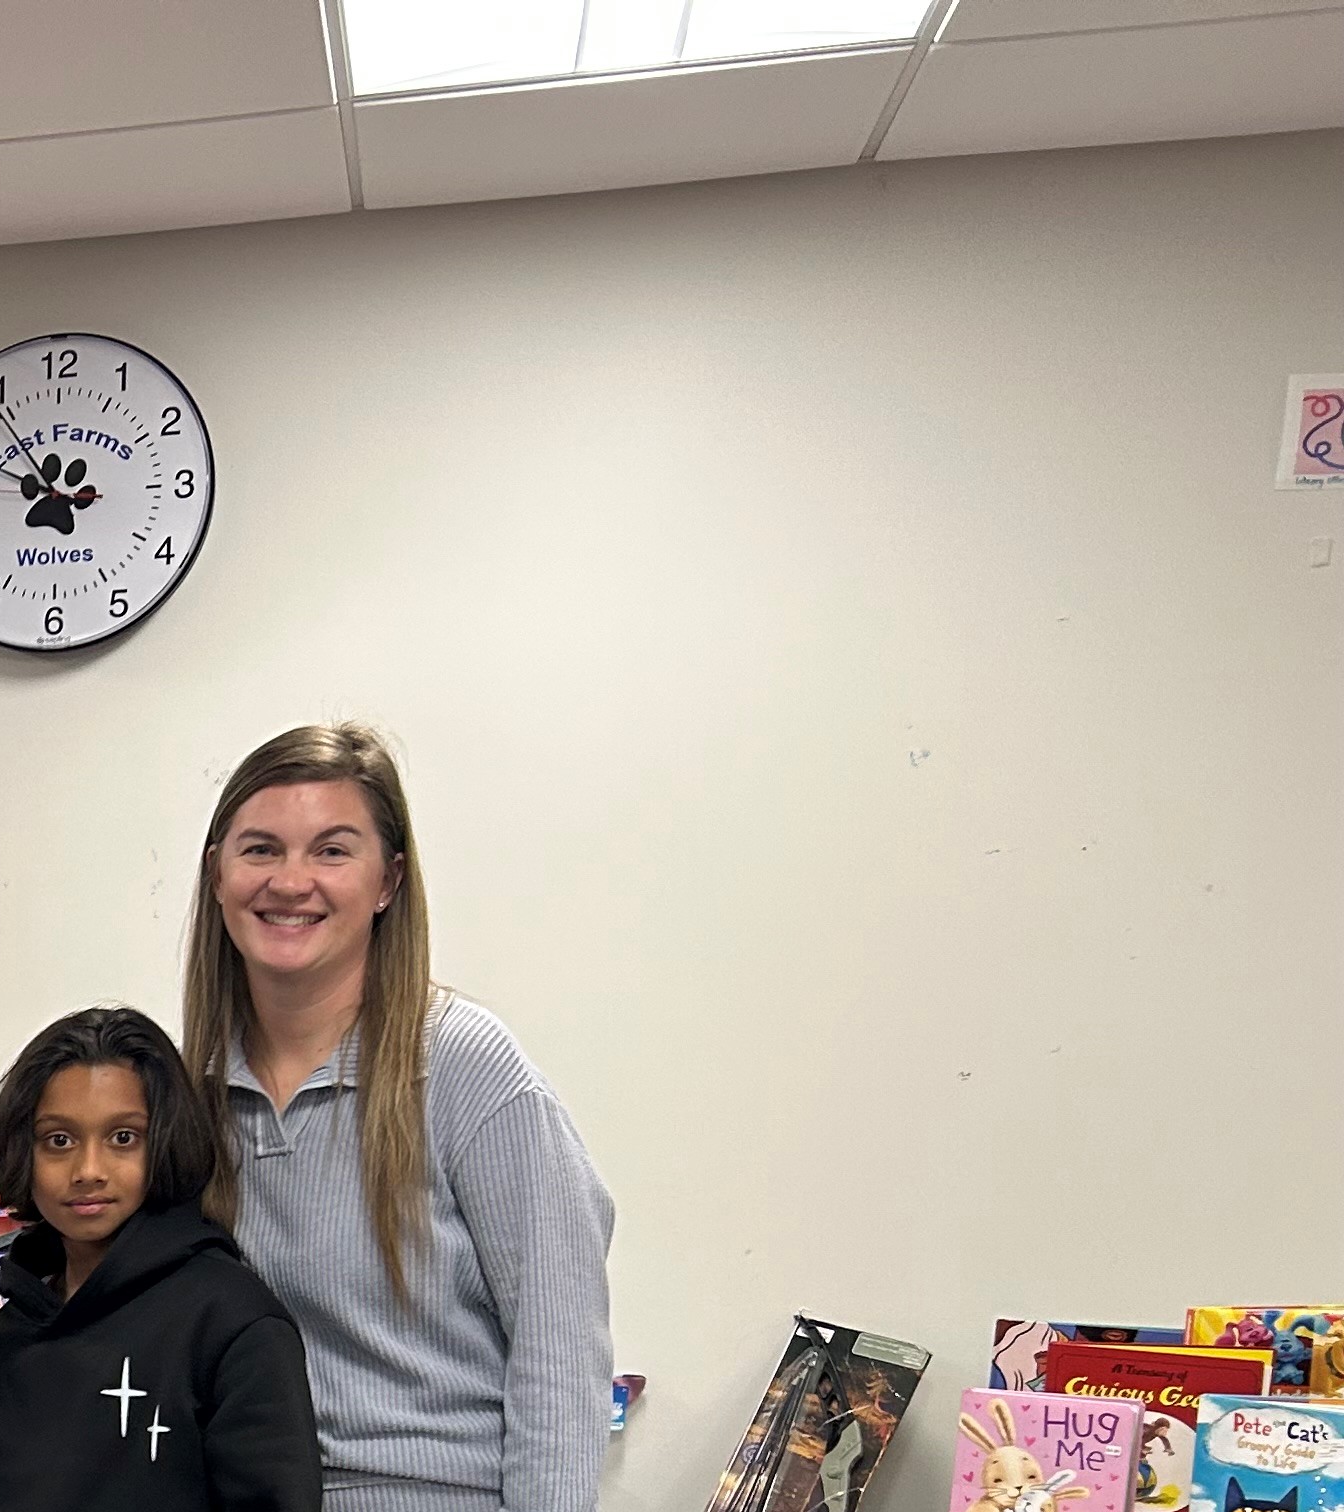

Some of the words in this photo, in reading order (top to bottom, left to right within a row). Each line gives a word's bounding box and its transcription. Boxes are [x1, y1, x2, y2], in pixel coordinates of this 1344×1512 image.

[41, 349, 79, 380] 12
[115, 363, 128, 392] 1
[161, 406, 182, 437] 2
[52, 424, 134, 462] Farms
[174, 469, 195, 499] 3
[16, 547, 95, 567] Wolves
[154, 536, 176, 566] 4
[108, 589, 129, 618] 5
[44, 607, 64, 636] 6
[1064, 1375, 1155, 1405] Curious
[1043, 1404, 1120, 1445] Hug
[1232, 1412, 1273, 1437] Pete
[1286, 1422, 1330, 1445] Cat's
[1055, 1438, 1106, 1472] Me
[1236, 1435, 1281, 1458] Groovy
[1283, 1442, 1317, 1461] Guide
[1256, 1453, 1269, 1467] to
[1273, 1456, 1298, 1471] Life
